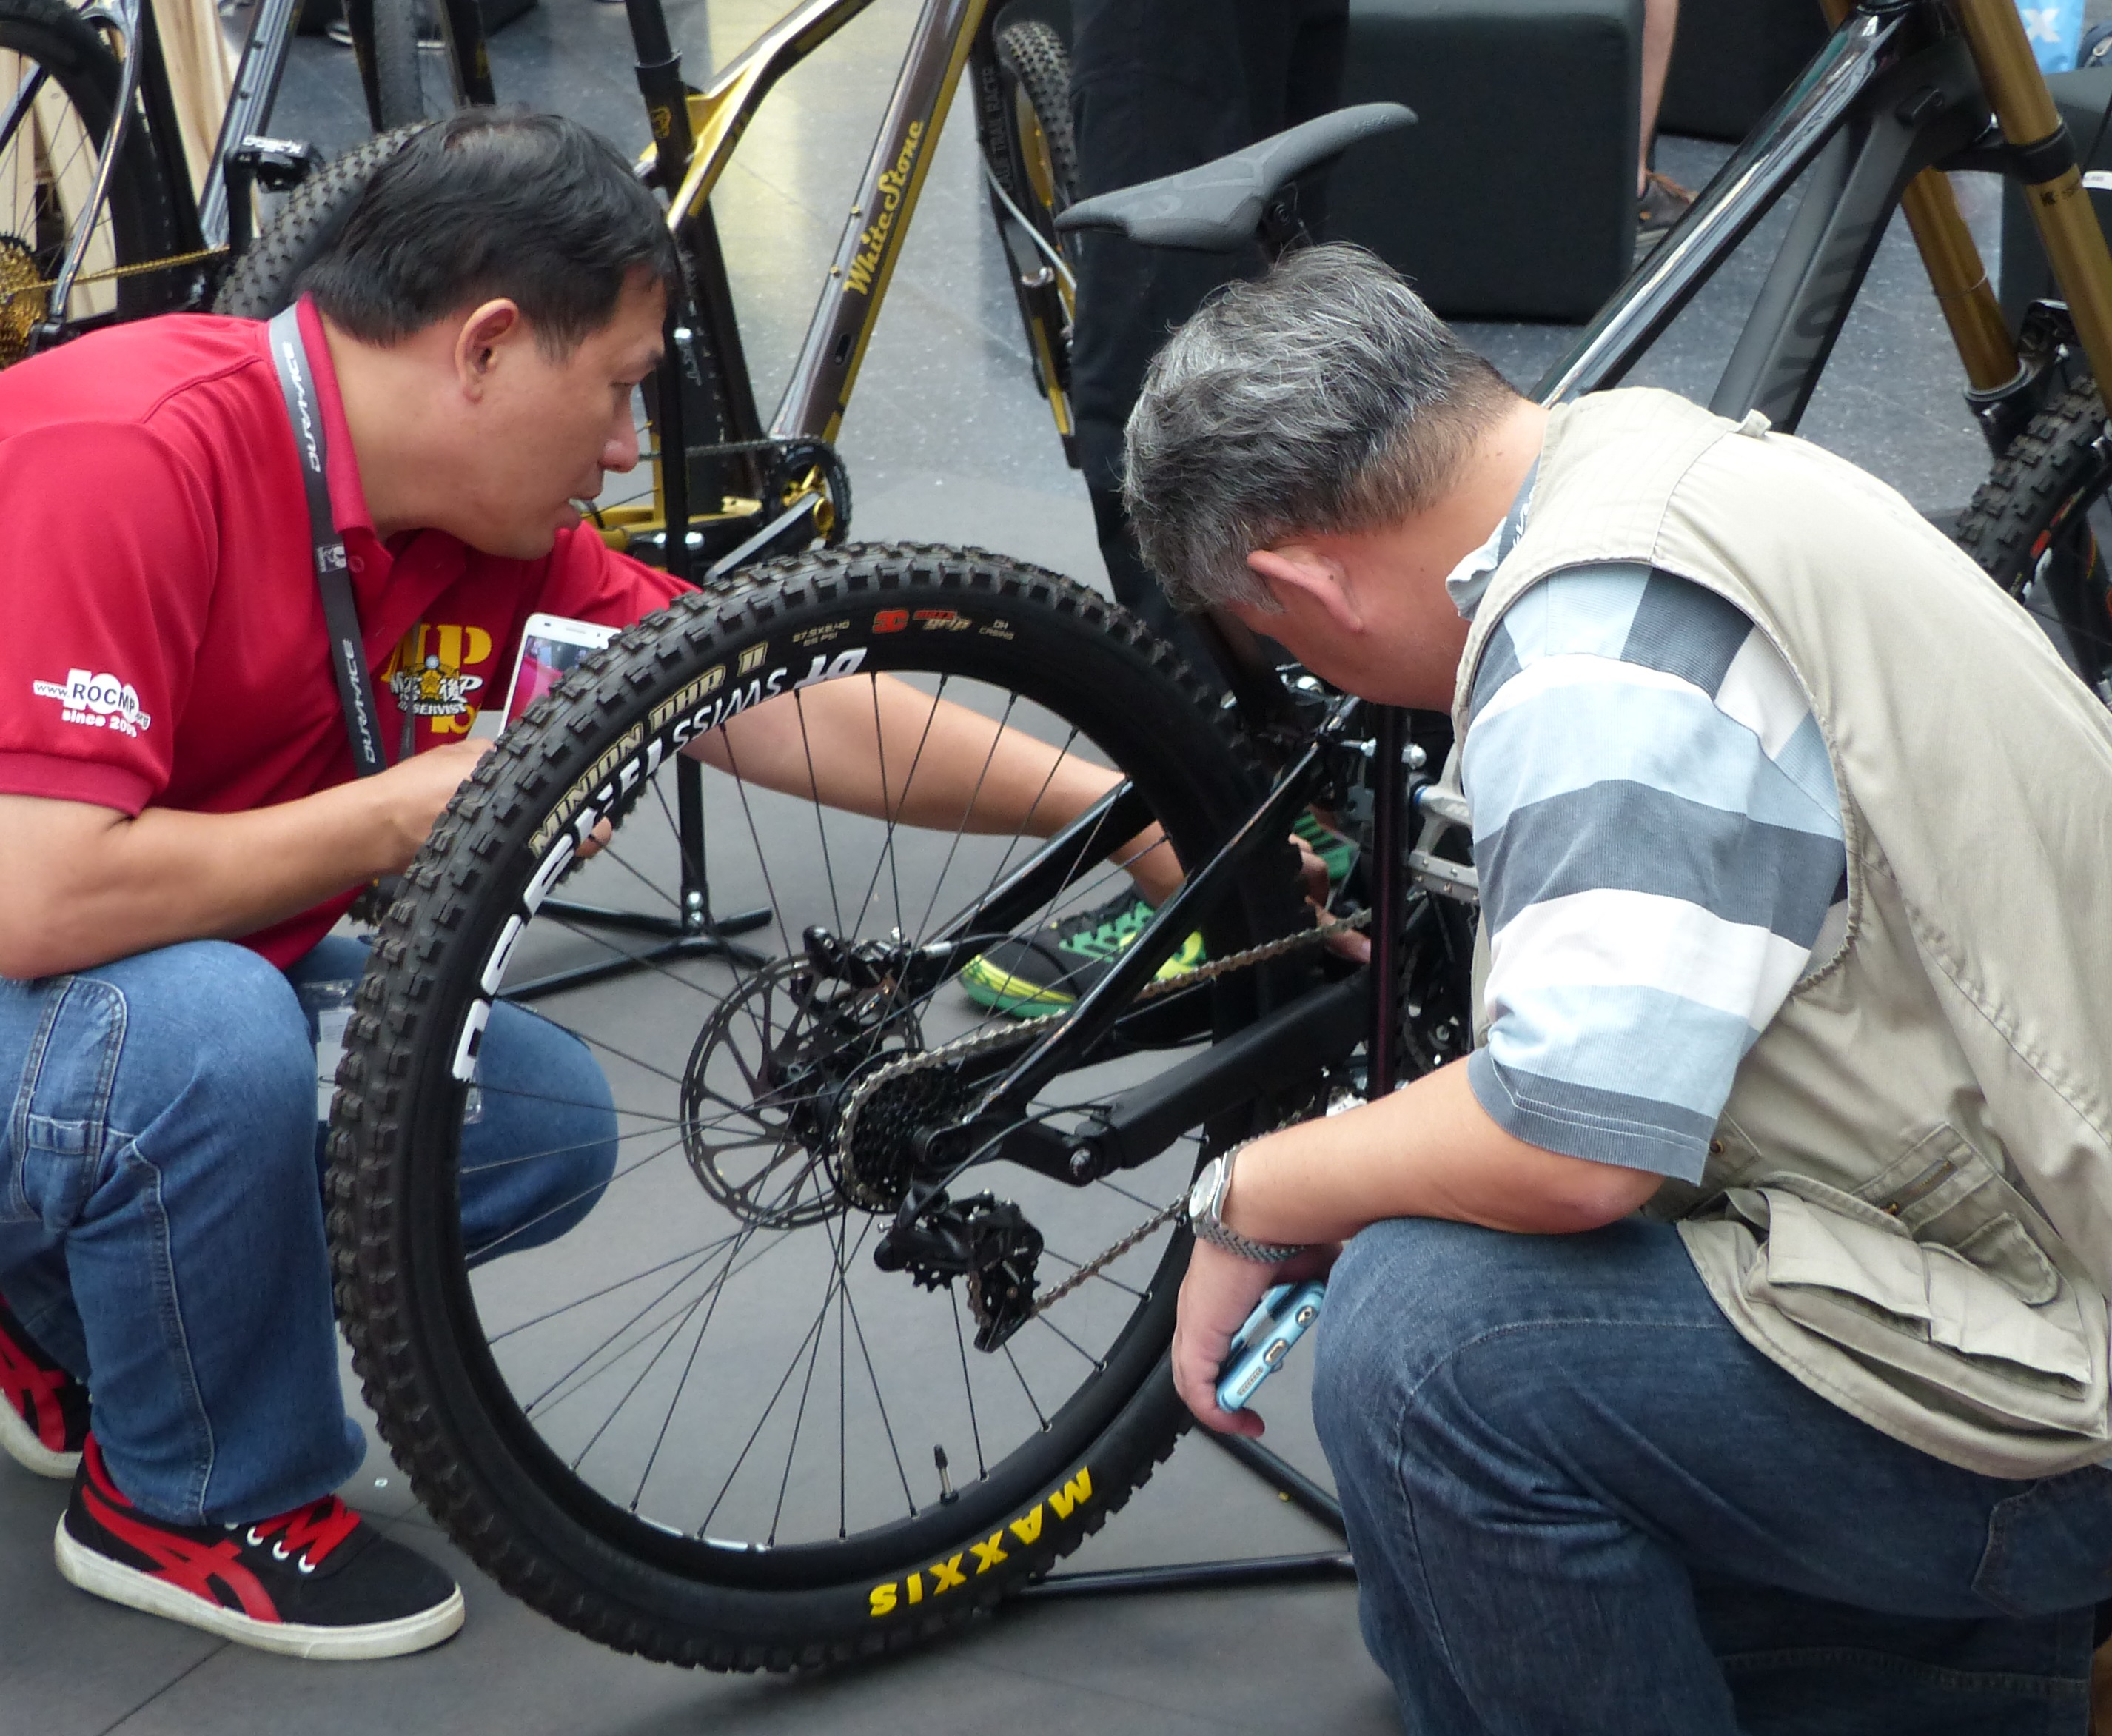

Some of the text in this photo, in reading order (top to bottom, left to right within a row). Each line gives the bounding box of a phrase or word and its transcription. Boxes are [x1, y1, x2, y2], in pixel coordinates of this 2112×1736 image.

[672, 666, 788, 751] SWISS
[793, 646, 868, 690] DT
[61, 708, 106, 728] since
[529, 722, 644, 859] MINION
[648, 663, 726, 735] DHR
[869, 1465, 1093, 1617] MAXXIS
